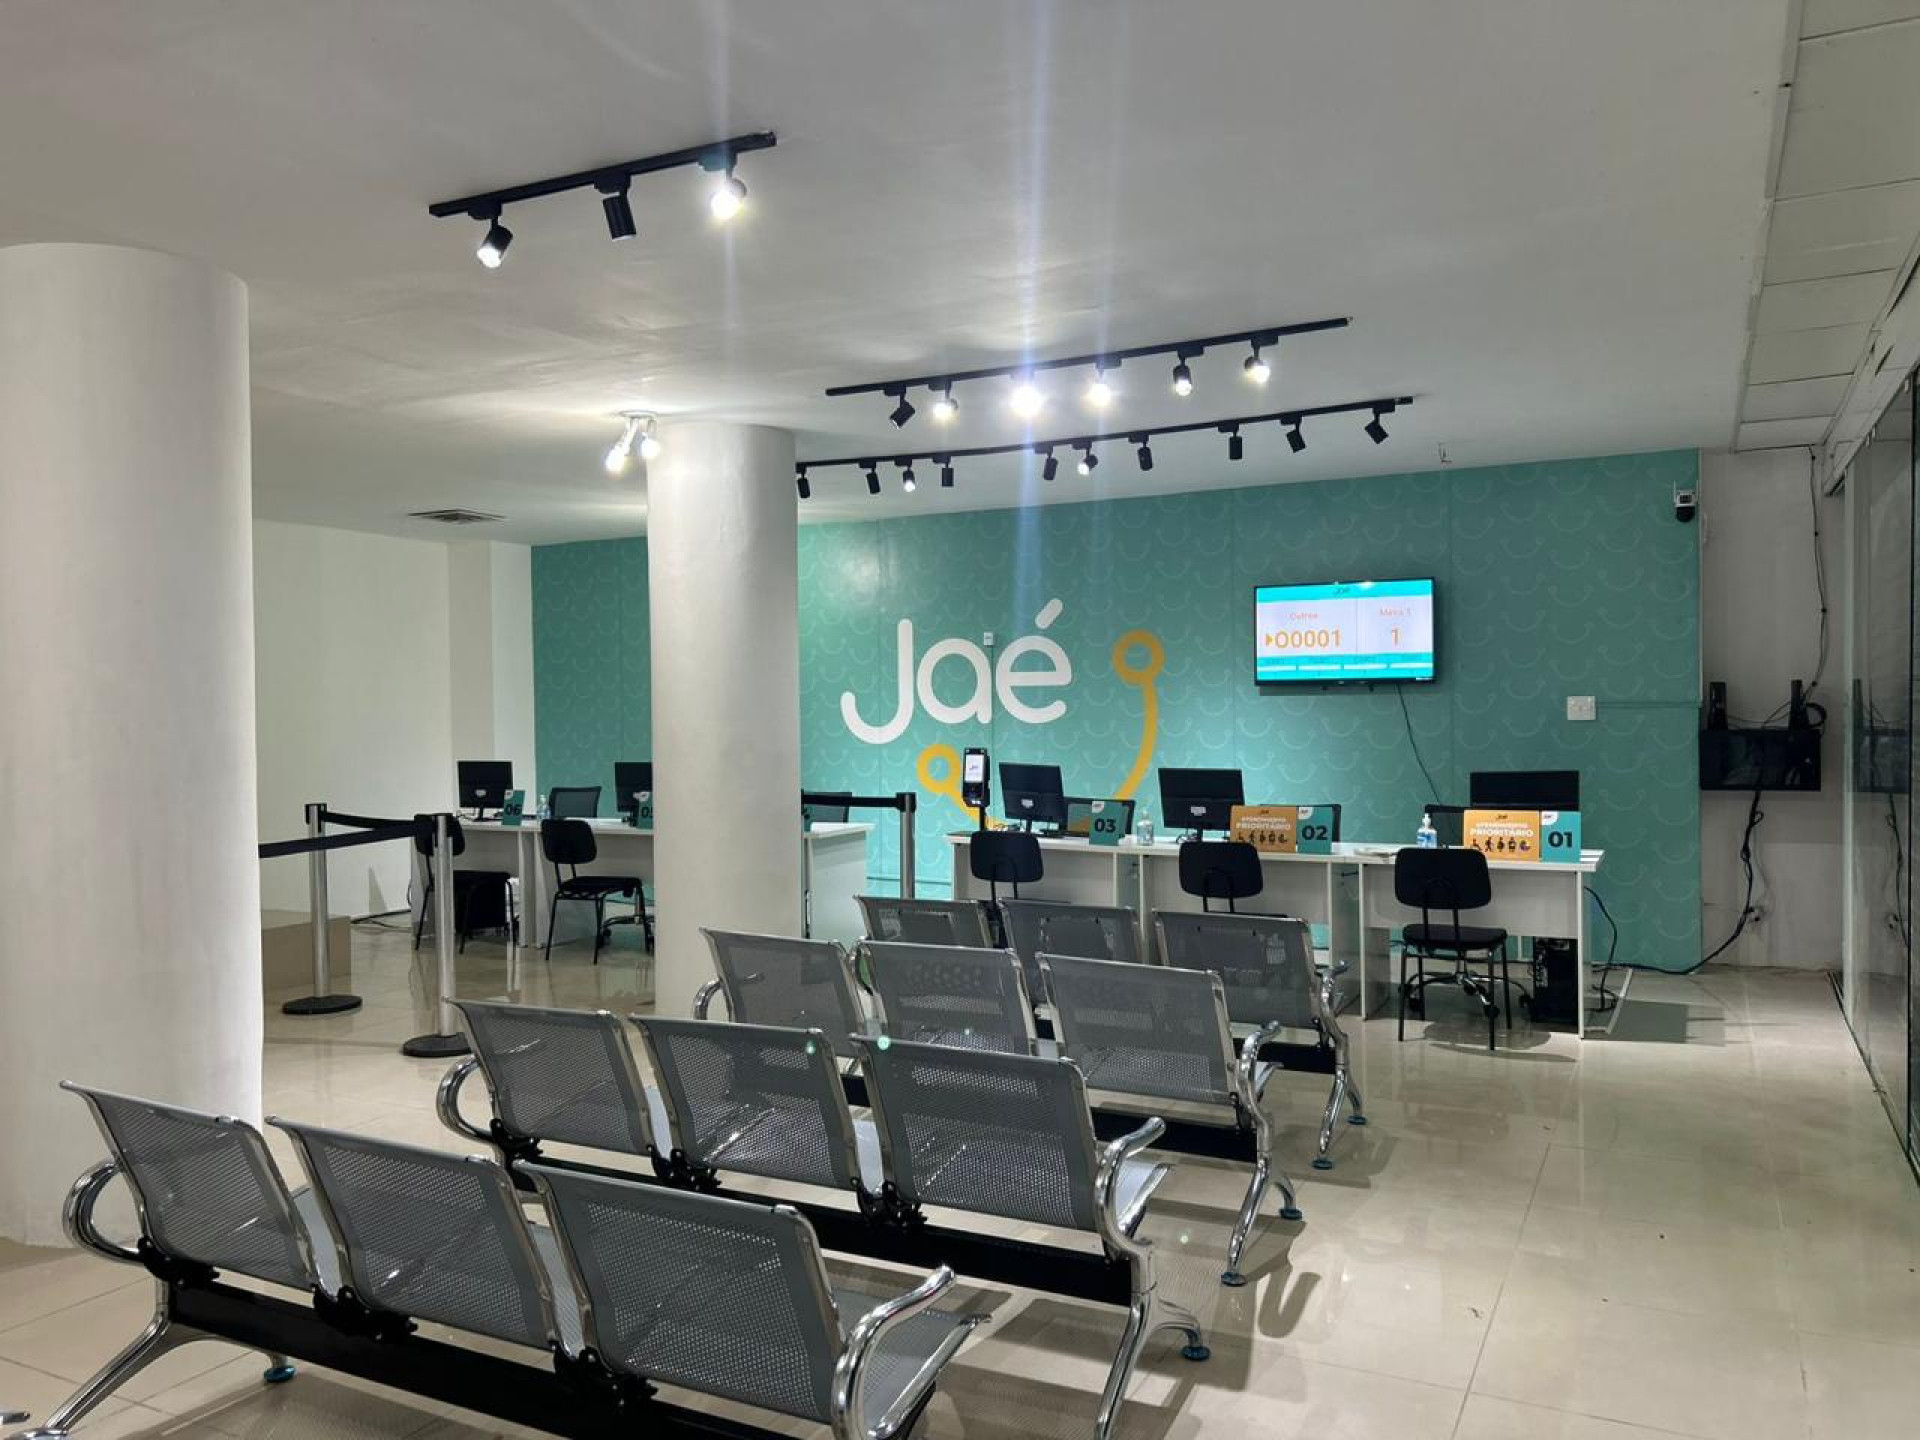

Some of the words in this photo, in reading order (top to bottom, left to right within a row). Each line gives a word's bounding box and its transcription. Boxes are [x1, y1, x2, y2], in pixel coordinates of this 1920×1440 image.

[840, 598, 1072, 744] Jaé
[1094, 818, 1117, 833] 03
[1302, 824, 1329, 841] 02
[1548, 830, 1573, 848] 01
